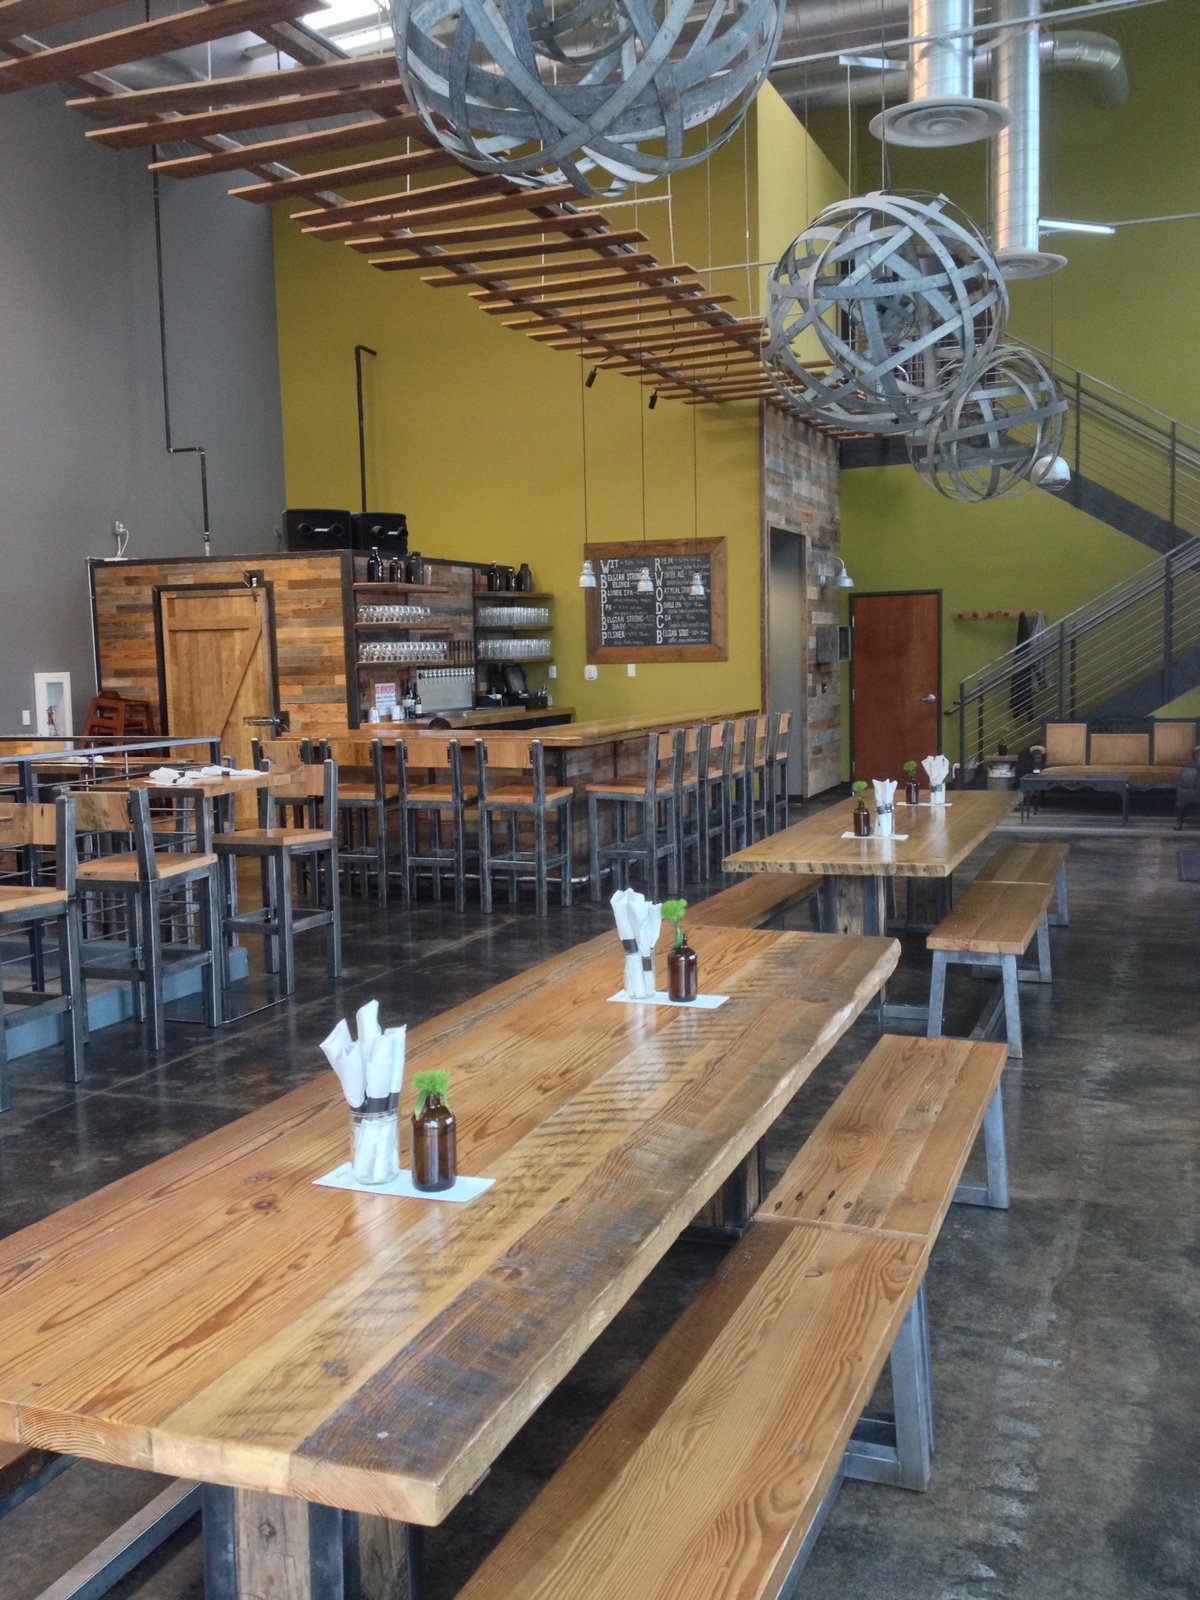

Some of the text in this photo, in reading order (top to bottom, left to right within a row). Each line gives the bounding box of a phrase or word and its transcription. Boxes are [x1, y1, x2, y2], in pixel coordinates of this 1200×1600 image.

[600, 559, 619, 574] WIT
[600, 573, 625, 588] BELGIAN
[601, 604, 612, 616] IPA
[602, 631, 625, 645] PILSNER
